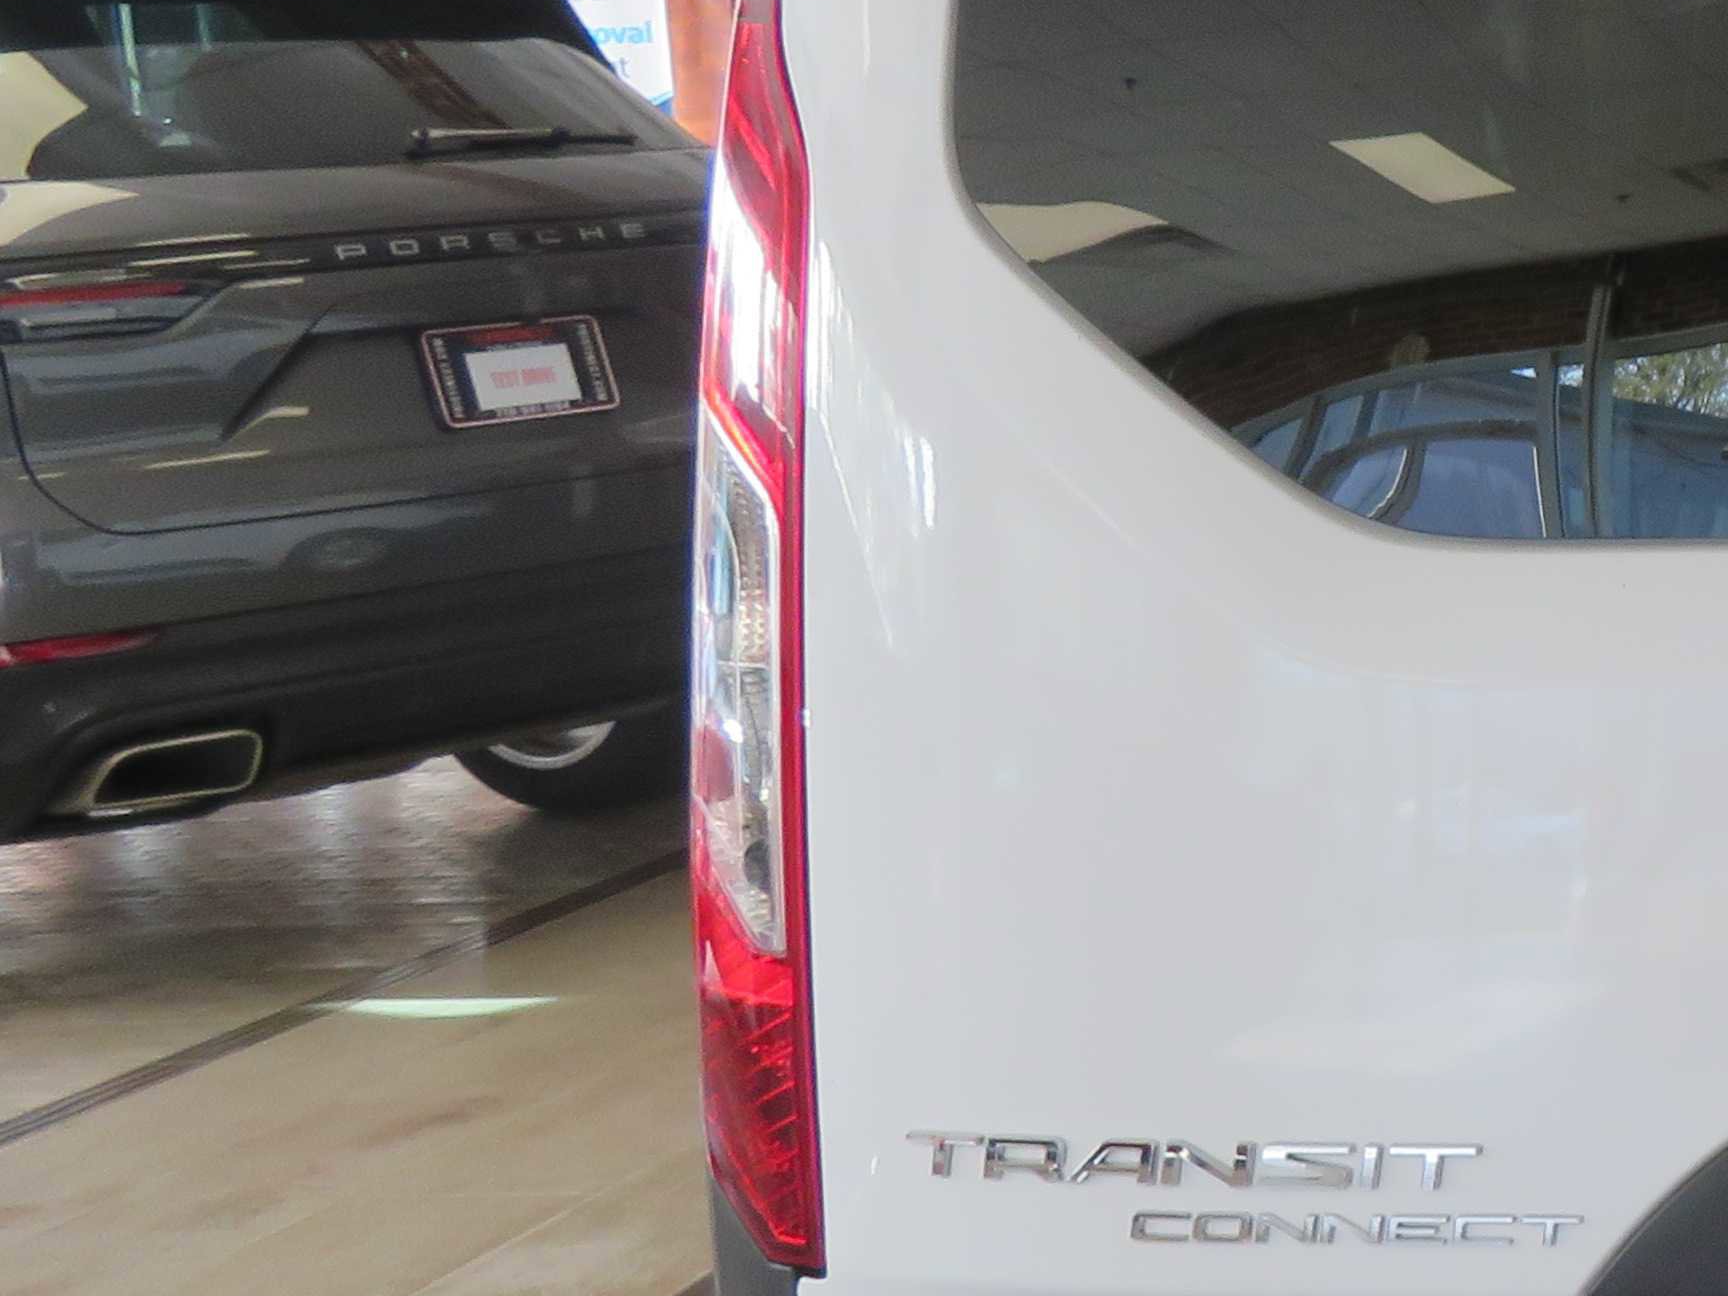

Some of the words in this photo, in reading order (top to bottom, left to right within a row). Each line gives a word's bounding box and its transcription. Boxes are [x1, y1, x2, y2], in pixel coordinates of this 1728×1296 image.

[590, 19, 653, 45] oval
[334, 222, 646, 261] PORSCHE
[905, 1129, 1484, 1191] TRANSIT
[1129, 1209, 1585, 1248] CONNECT
